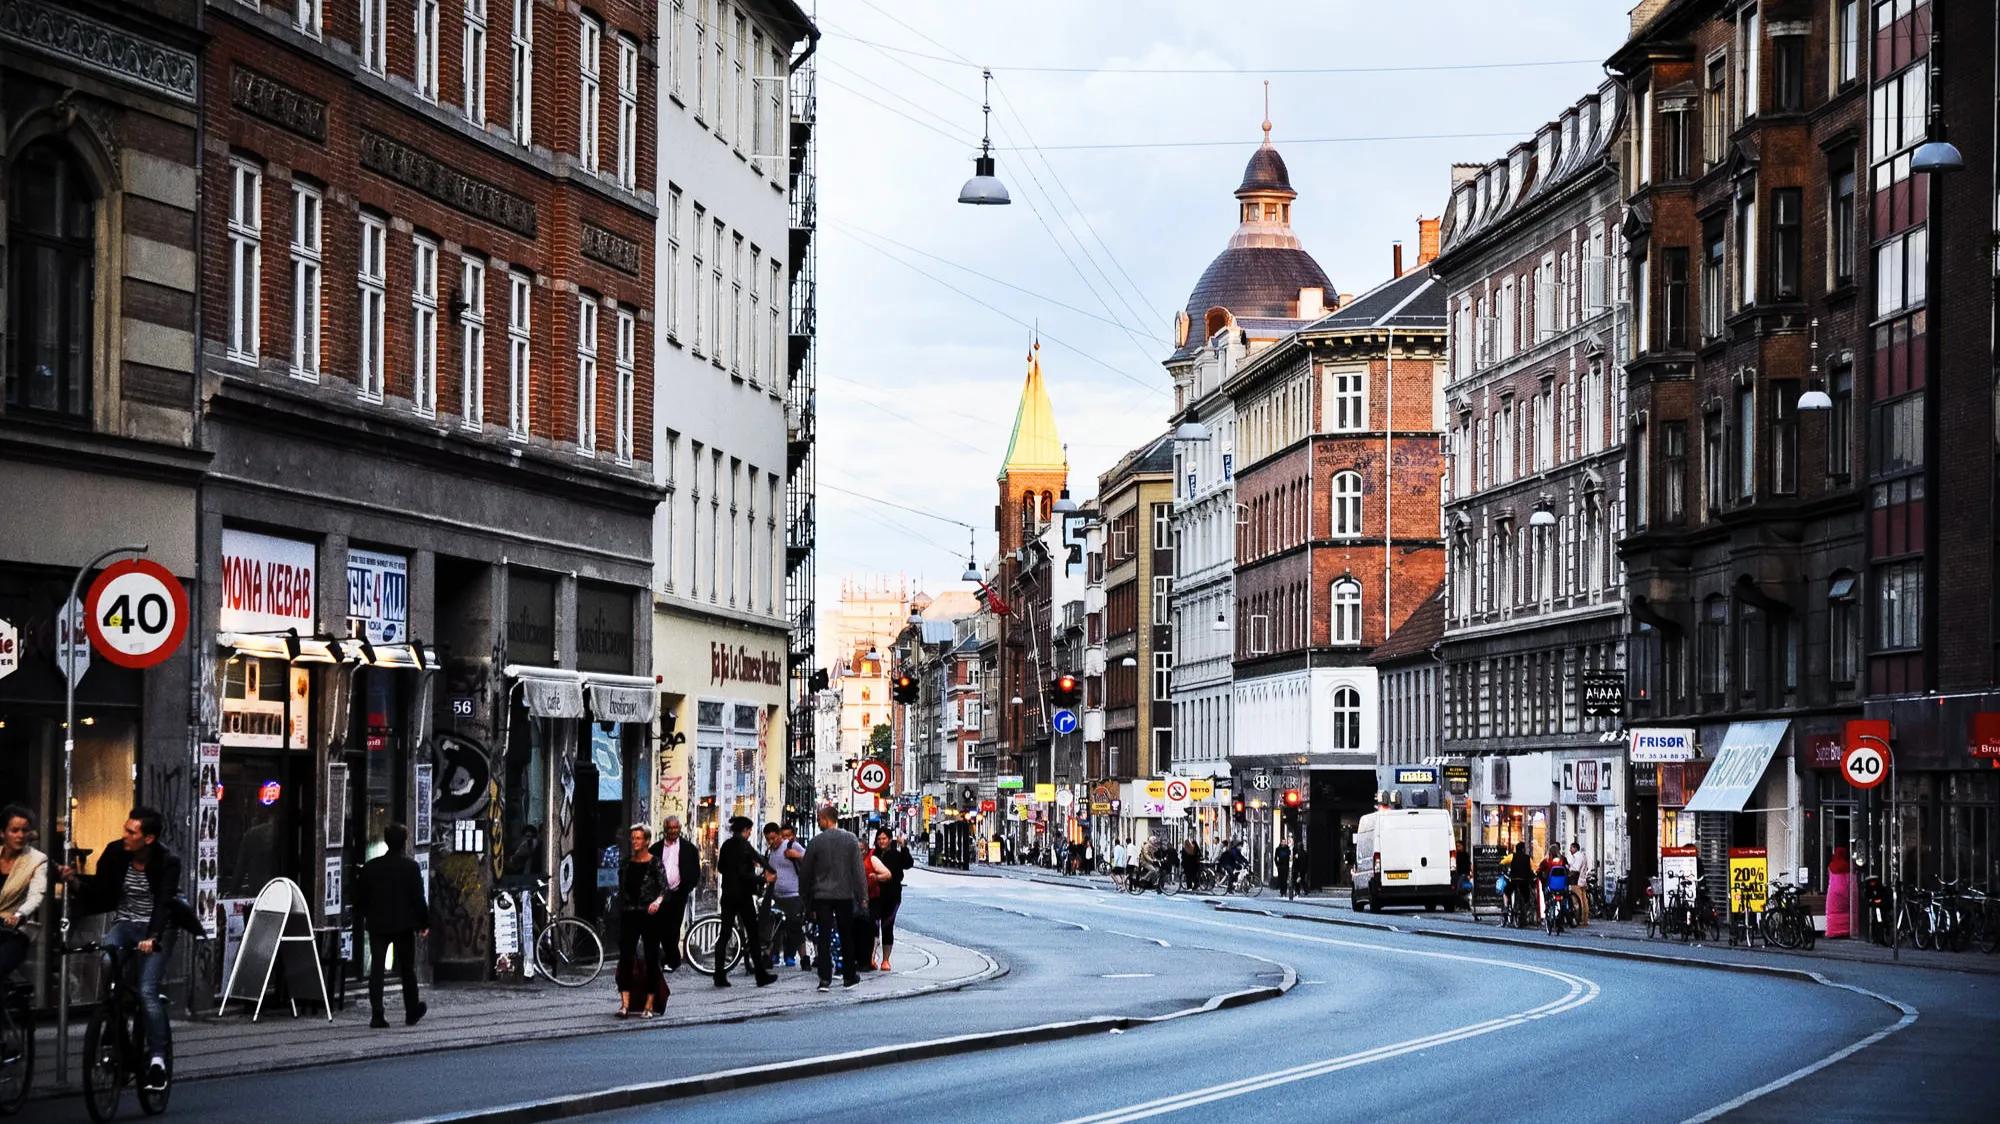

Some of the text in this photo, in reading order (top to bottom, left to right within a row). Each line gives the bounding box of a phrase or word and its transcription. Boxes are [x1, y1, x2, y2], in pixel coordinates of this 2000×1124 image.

[222, 554, 310, 619] MONA KEBAB
[383, 572, 405, 620] ALL
[103, 594, 168, 634] 40
[739, 645, 761, 683] Chinese
[762, 650, 781, 686] Market
[453, 700, 471, 714] 56
[1639, 736, 1684, 748] FRISØR
[1981, 744, 2000, 756] Bru
[1850, 757, 1880, 774] 40
[863, 770, 883, 783] 40
[1734, 866, 1764, 882] 20%
